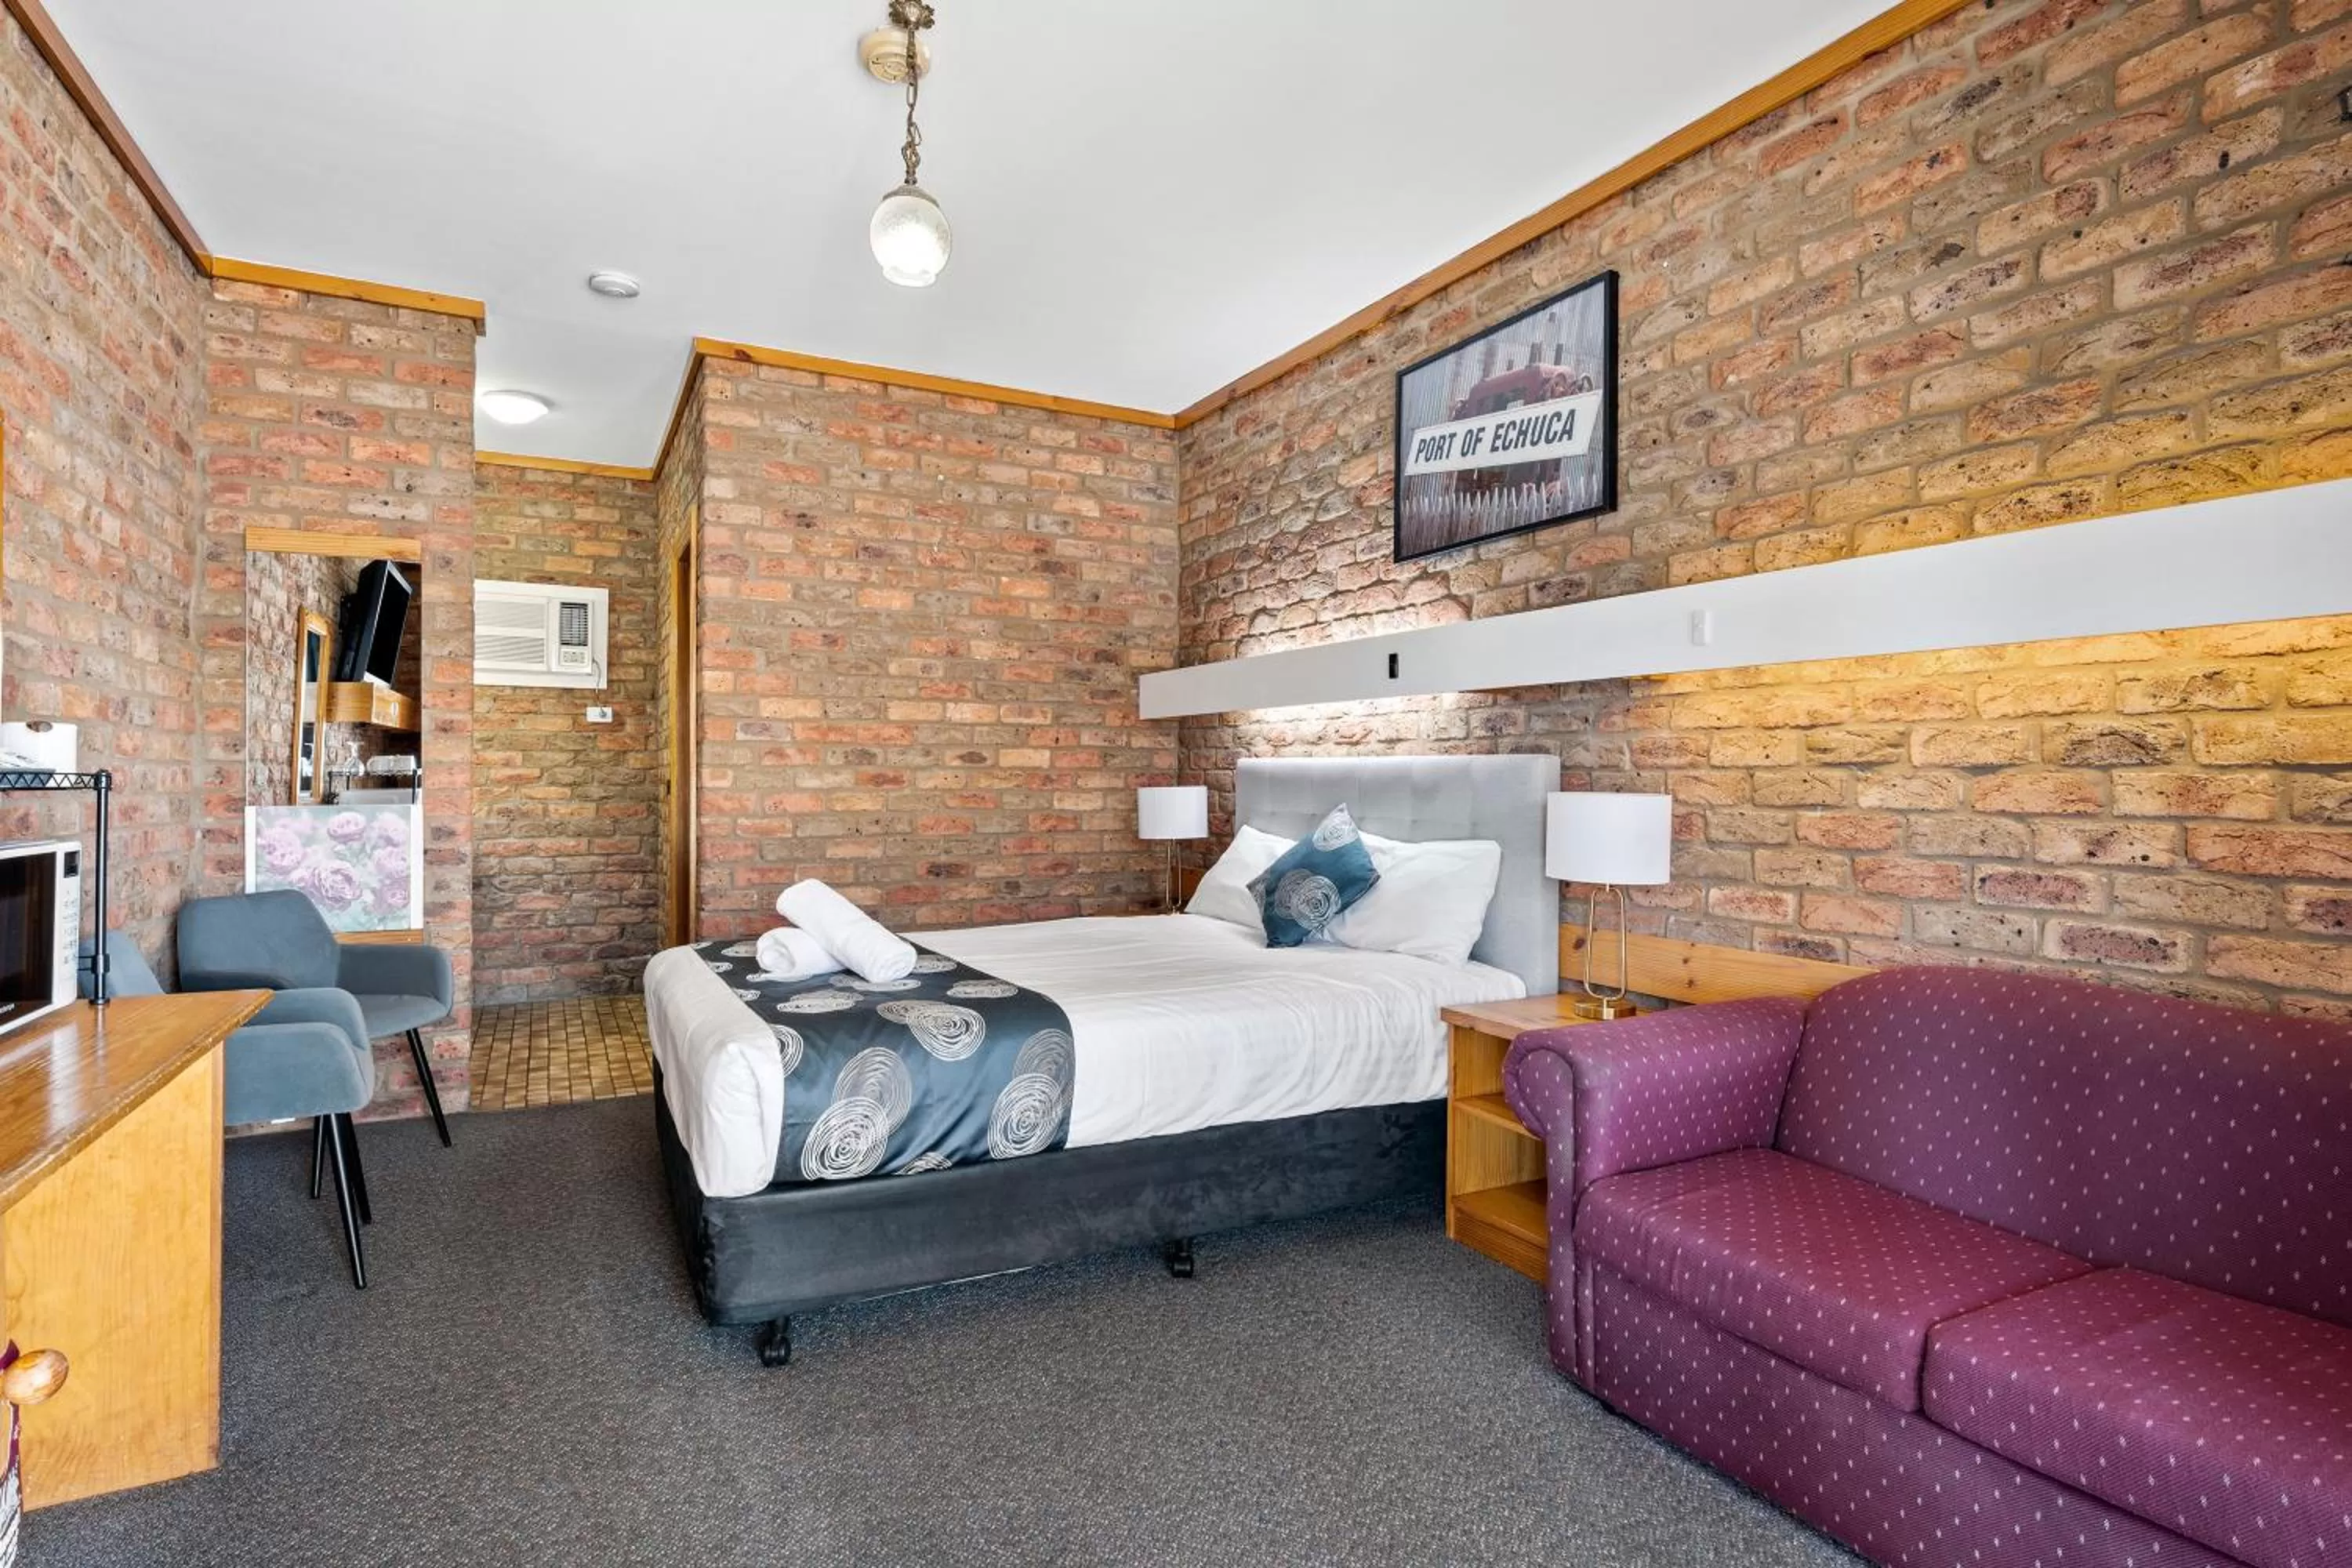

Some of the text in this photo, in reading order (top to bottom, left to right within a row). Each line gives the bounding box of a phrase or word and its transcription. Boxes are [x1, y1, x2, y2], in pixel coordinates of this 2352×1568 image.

[1414, 408, 1576, 463] PORT OF ECHUCA
